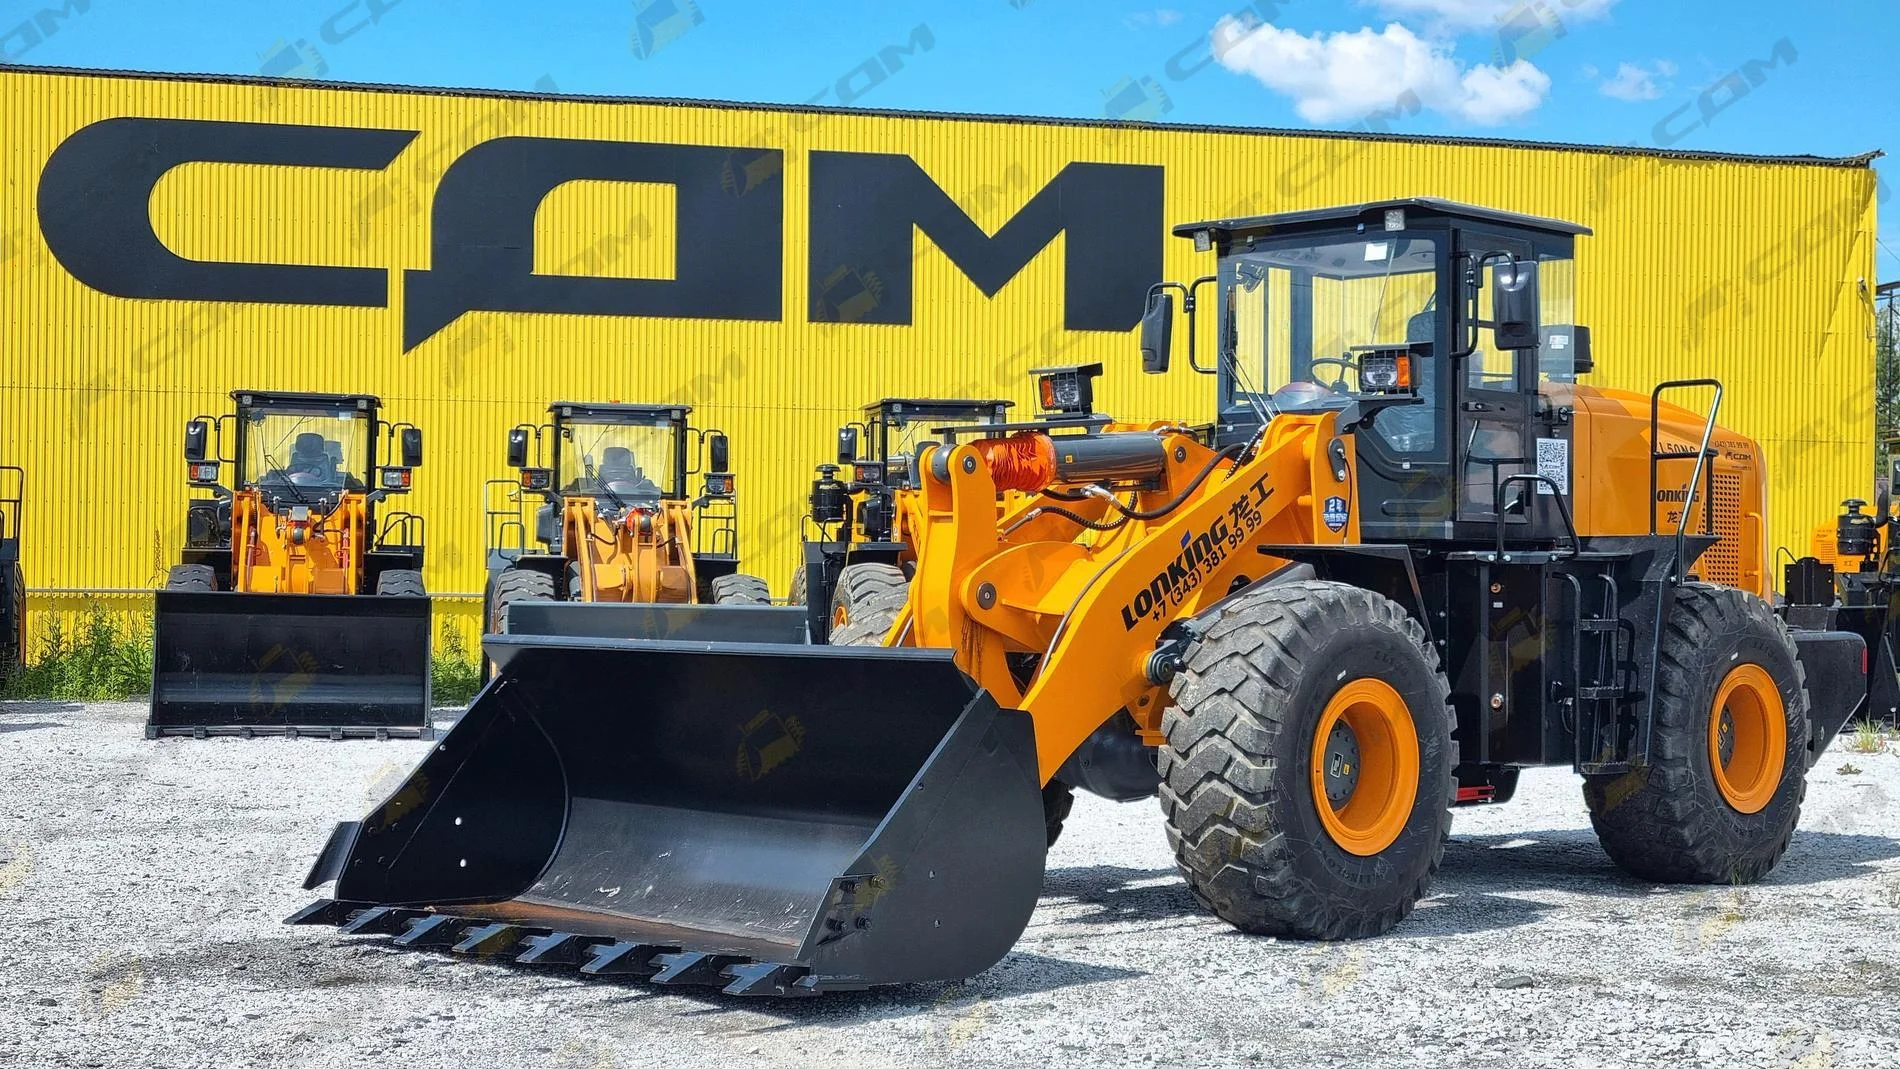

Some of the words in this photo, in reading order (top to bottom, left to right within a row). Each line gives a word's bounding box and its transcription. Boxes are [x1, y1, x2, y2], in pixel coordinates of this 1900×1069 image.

[1228, 472, 1275, 528] 龙工
[1152, 601, 1167, 622] +7
[1170, 567, 1202, 607] (343)
[1203, 545, 1228, 575] 381
[1228, 527, 1245, 550] 99
[1245, 510, 1262, 532] 99
